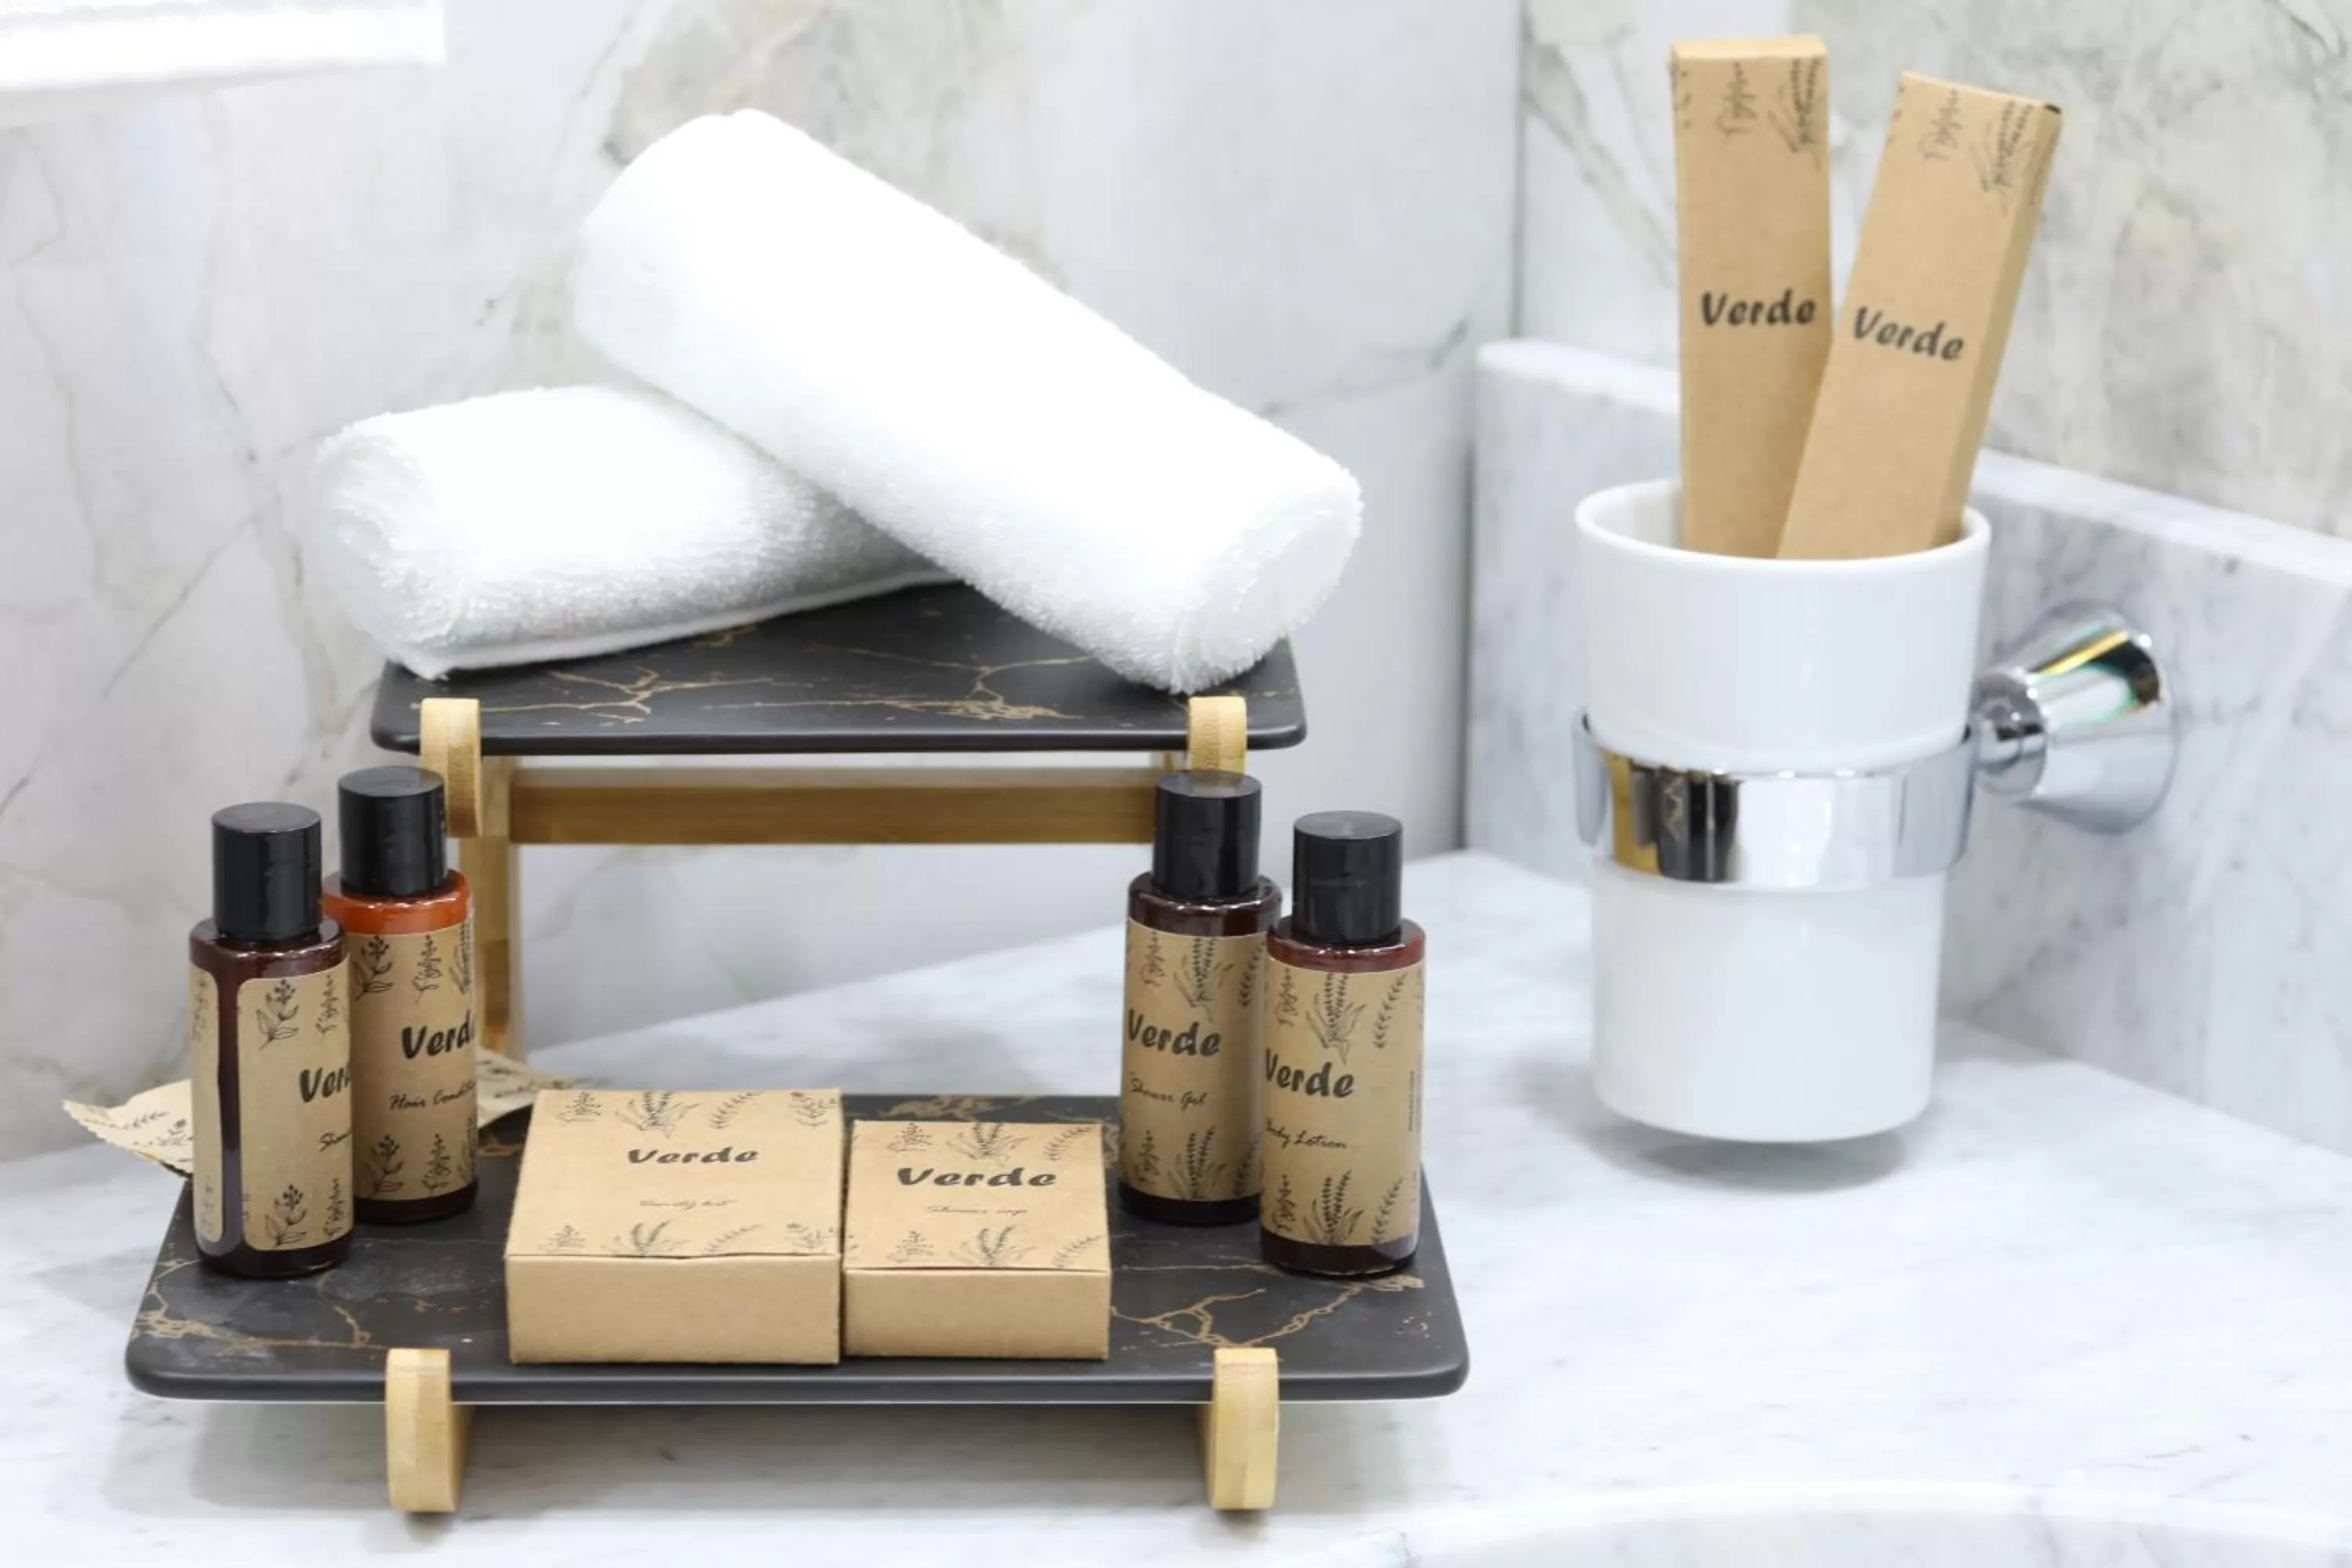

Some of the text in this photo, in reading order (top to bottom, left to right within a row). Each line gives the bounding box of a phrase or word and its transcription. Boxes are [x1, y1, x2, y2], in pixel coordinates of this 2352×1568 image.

[1700, 288, 1816, 327] Verde
[1853, 305, 1965, 362] Verde
[401, 1008, 475, 1060] Verd
[1127, 1008, 1221, 1056] Verde
[299, 1066, 351, 1103] Ver
[1265, 1048, 1355, 1098] Verde
[627, 1145, 760, 1164] Verde
[897, 1167, 1057, 1186] Verde
